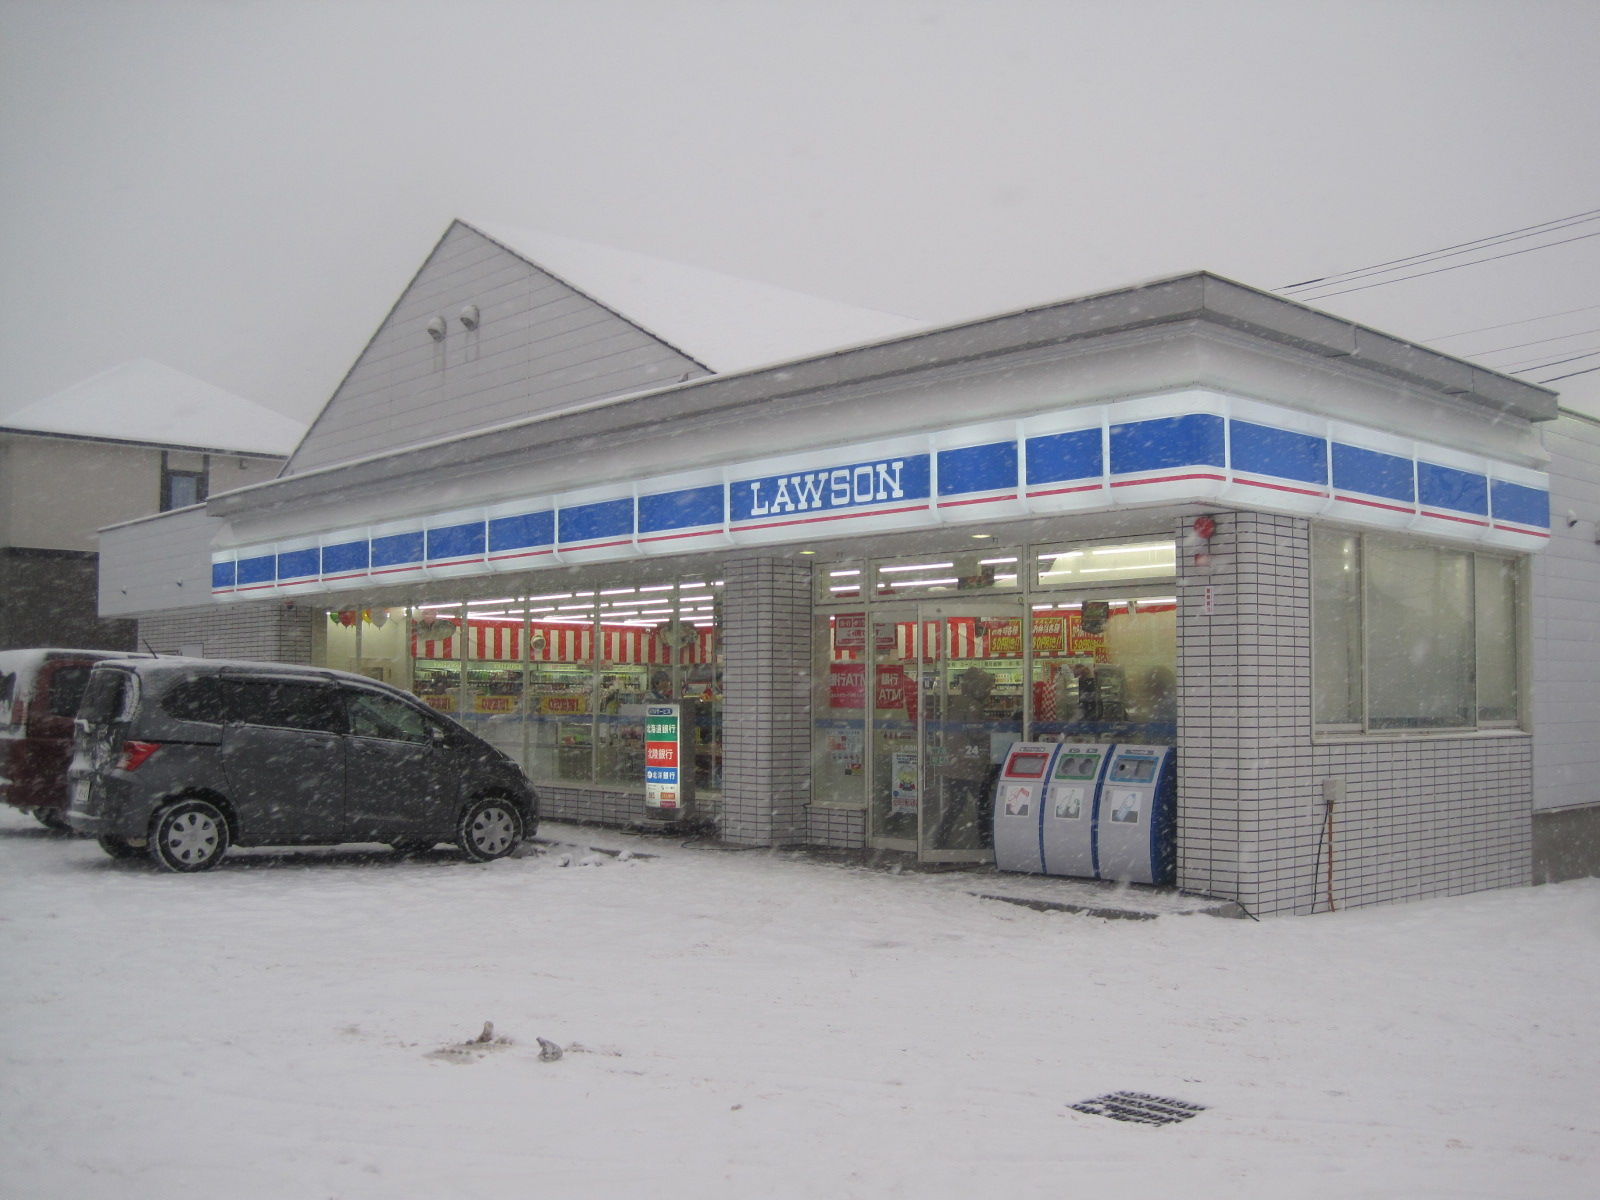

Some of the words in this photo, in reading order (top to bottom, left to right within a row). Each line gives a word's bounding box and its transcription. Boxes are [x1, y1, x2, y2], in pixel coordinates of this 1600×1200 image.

[750, 461, 904, 516] LAWSON
[879, 688, 902, 701] ATM
[646, 724, 676, 734] 北海道銀行
